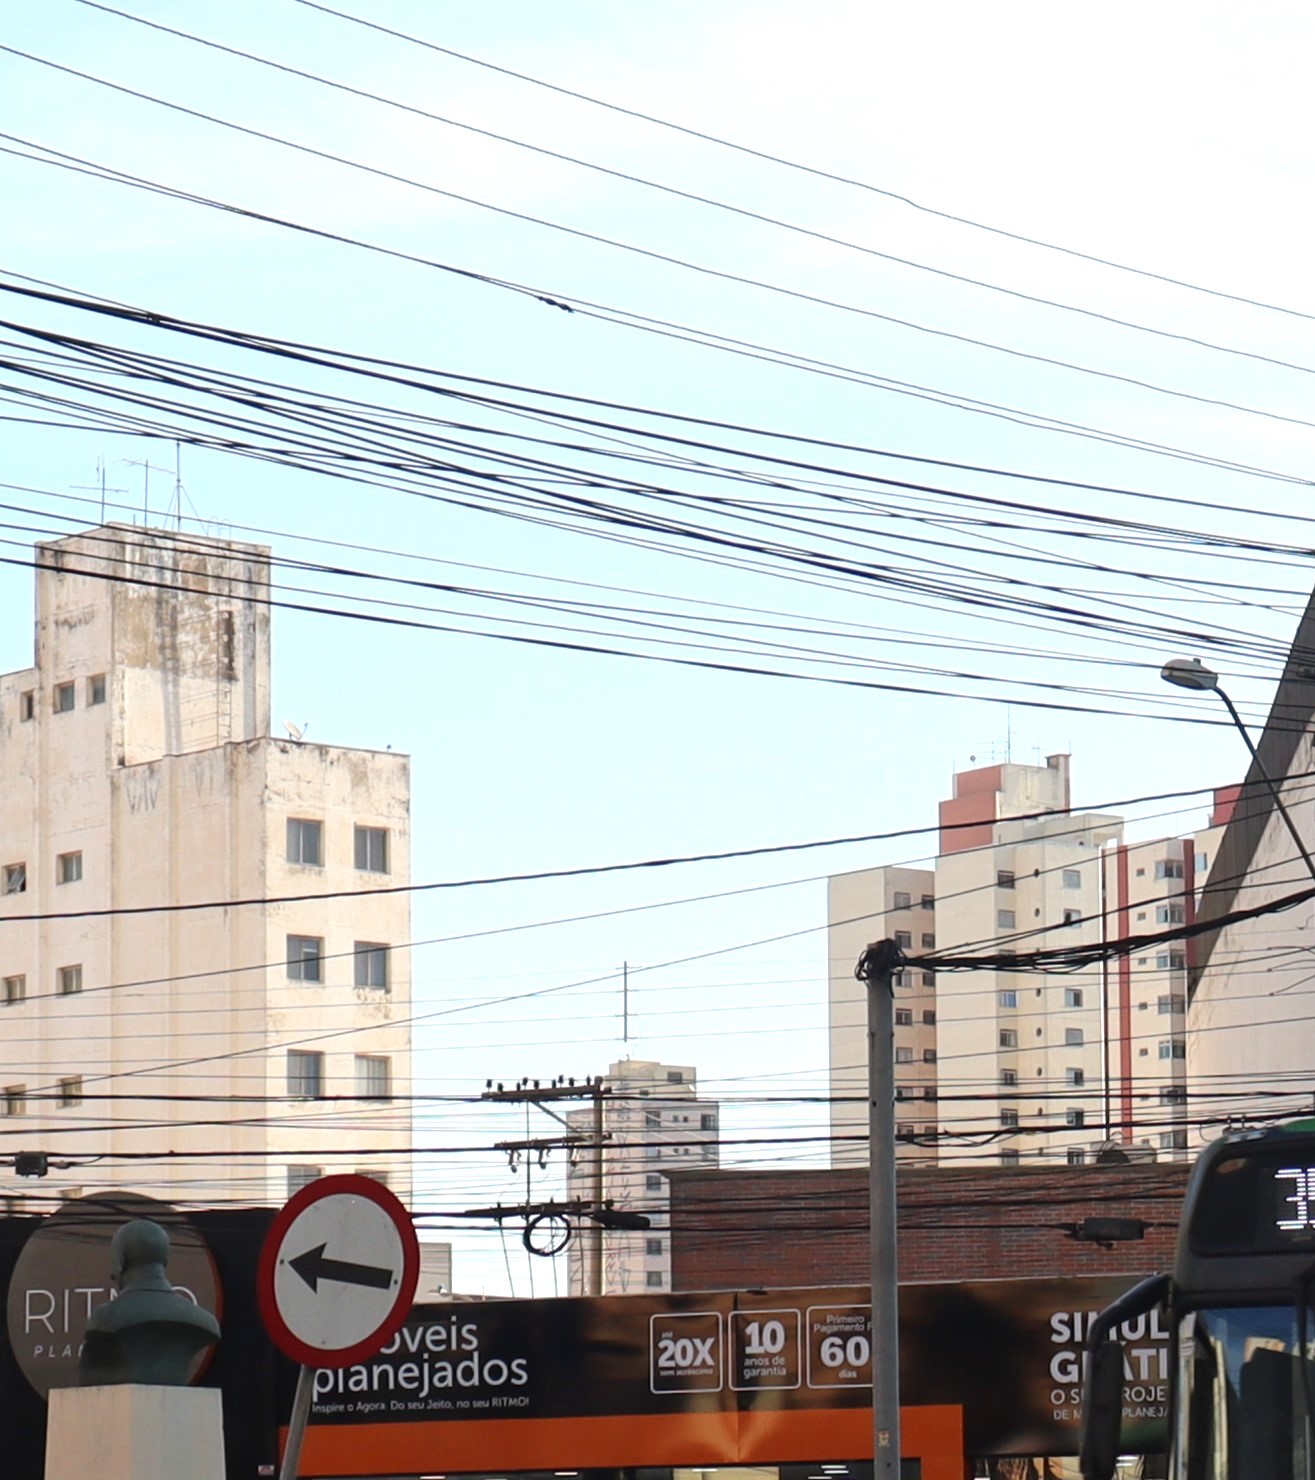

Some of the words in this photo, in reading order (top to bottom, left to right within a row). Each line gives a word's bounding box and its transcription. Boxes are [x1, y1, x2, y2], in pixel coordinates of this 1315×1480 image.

[826, 1315, 865, 1324] Primeiro
[813, 1323, 865, 1334] Pagamento
[744, 1320, 786, 1354] 10
[33, 1342, 86, 1358] PLA
[658, 1337, 715, 1368] 20X
[820, 1336, 870, 1367] 60
[744, 1357, 770, 1367] anos
[772, 1355, 786, 1366] de
[312, 1351, 528, 1403] planejados
[743, 1367, 787, 1379] garantia
[838, 1369, 858, 1379] dias
[1051, 1389, 1066, 1405] O
[312, 1402, 345, 1414] Inspire
[347, 1404, 353, 1412] o
[391, 1400, 404, 1411] Do
[407, 1402, 424, 1411] seu
[457, 1401, 470, 1409] no
[473, 1400, 489, 1409] seu
[492, 1397, 530, 1408] RITMO!
[1053, 1409, 1070, 1420] DE
